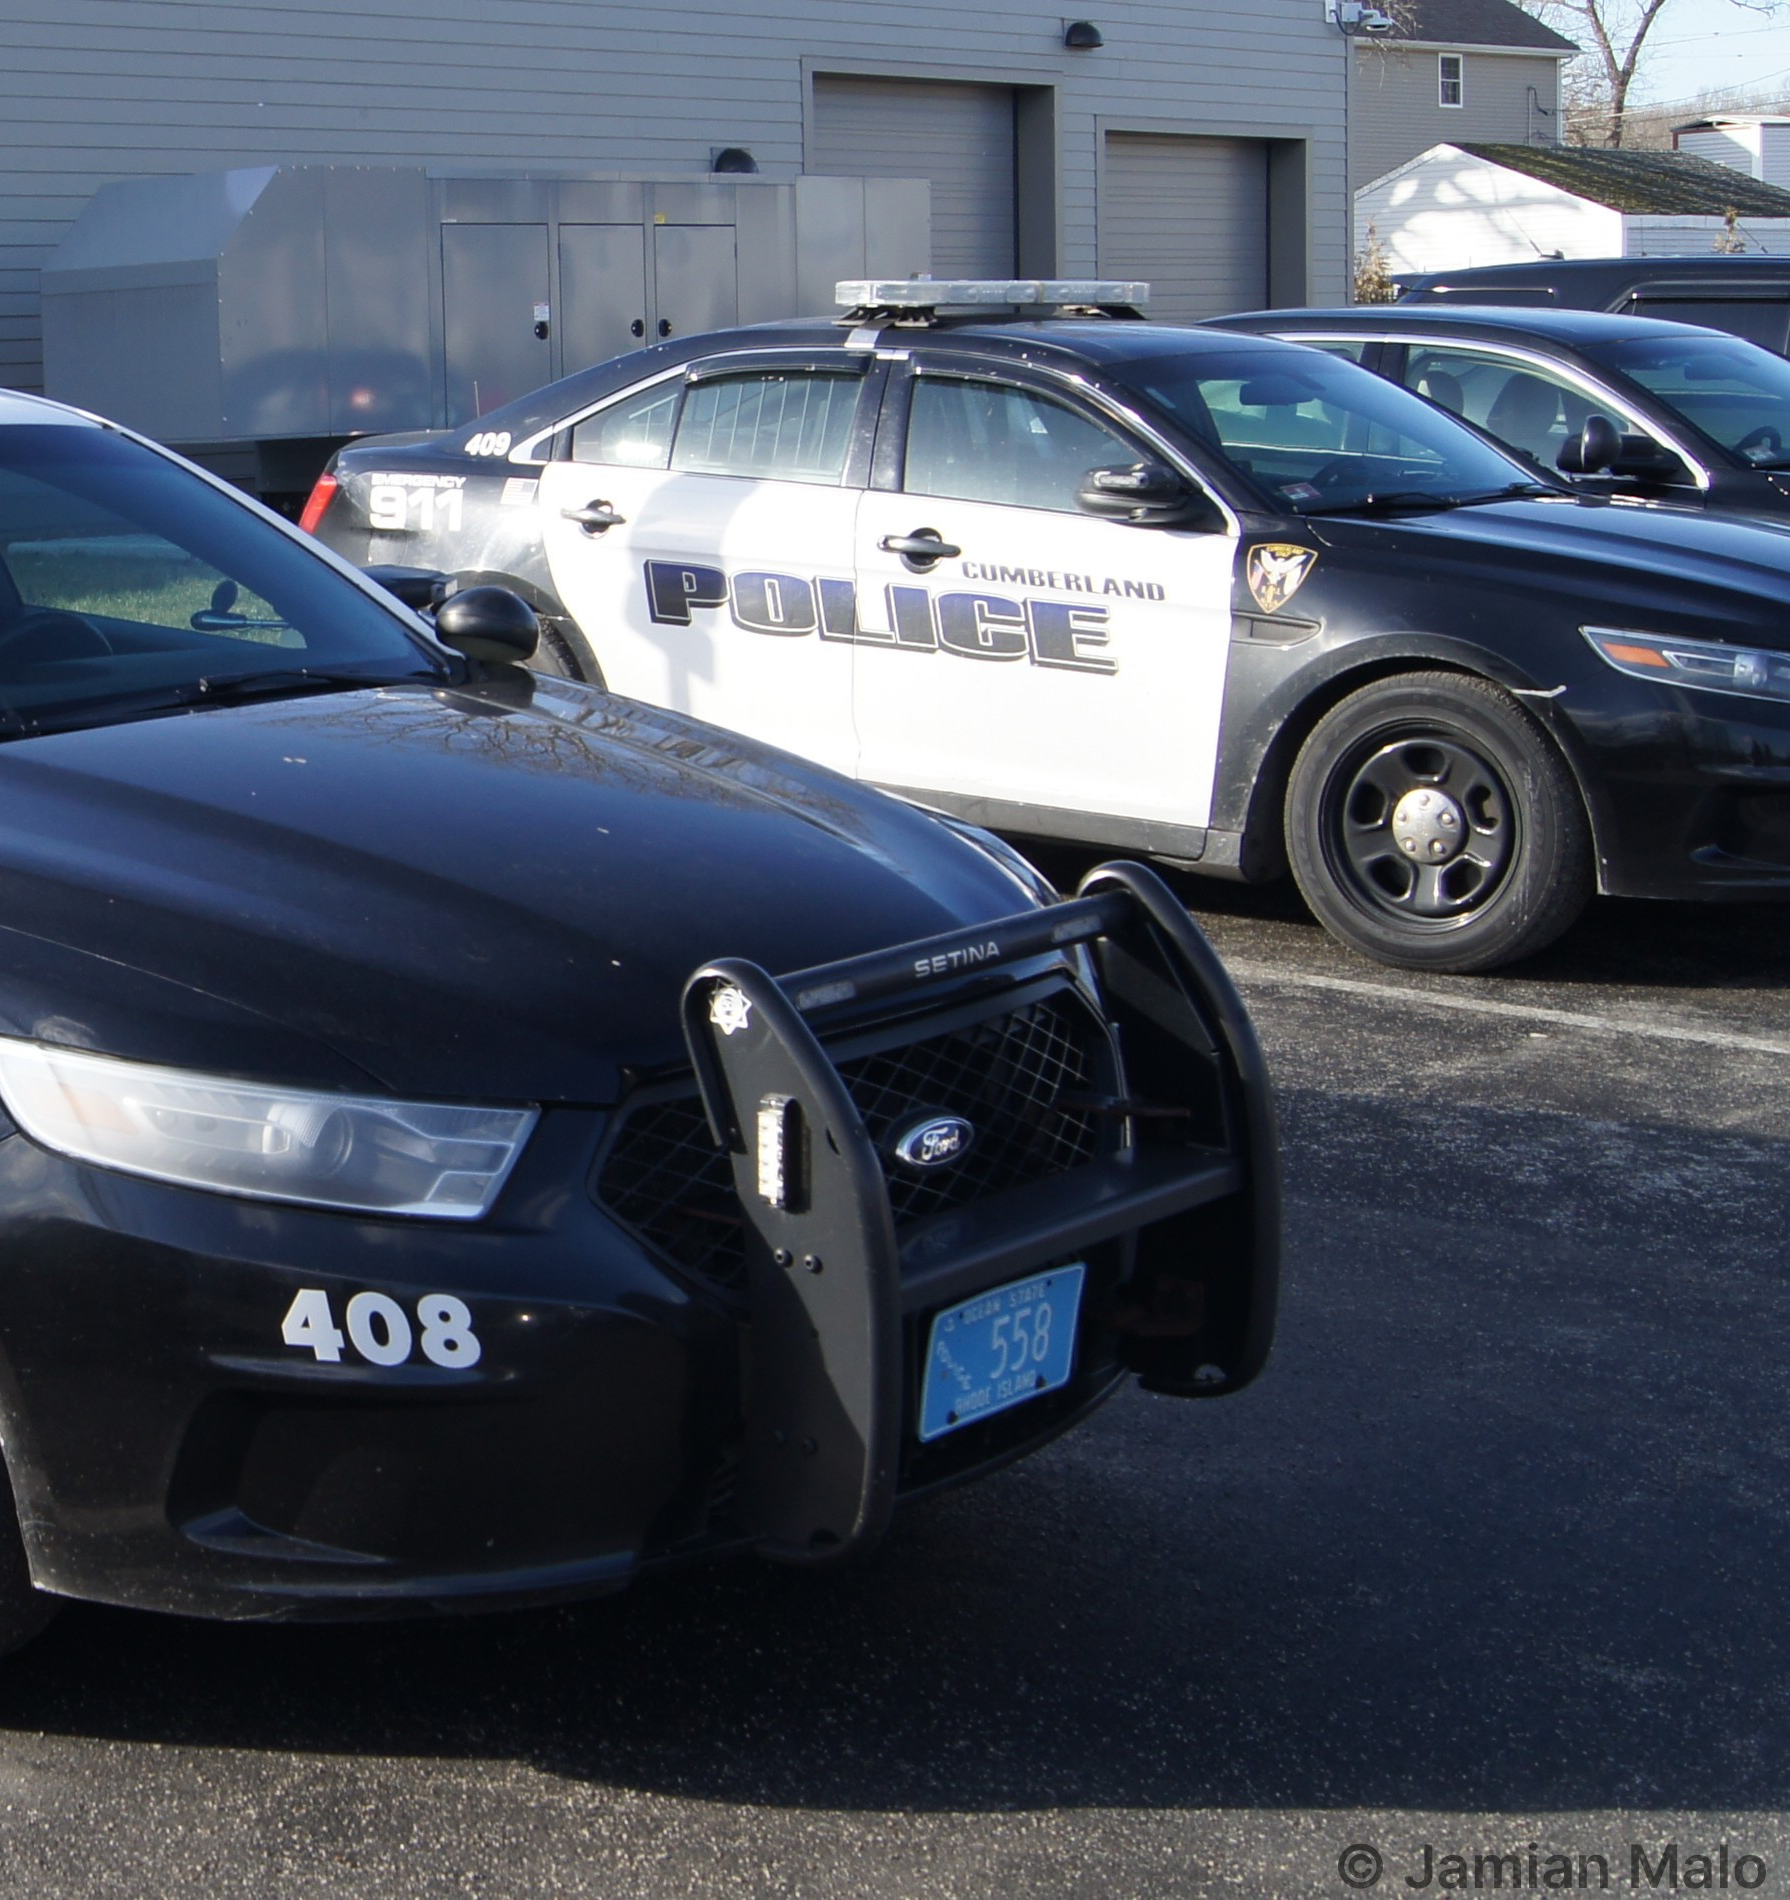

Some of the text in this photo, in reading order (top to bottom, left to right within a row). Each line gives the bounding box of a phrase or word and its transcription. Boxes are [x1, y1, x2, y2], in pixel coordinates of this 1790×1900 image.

[464, 431, 512, 457] 409
[371, 472, 467, 488] EMERGENCY
[369, 485, 464, 532] 911
[961, 560, 1166, 602] CUMBERLAND
[643, 558, 1119, 677] POLICE
[914, 941, 1001, 979] SETINA
[921, 1127, 961, 1161] Ford
[963, 1282, 1047, 1325] OCEAN STATE
[280, 1288, 482, 1369] 408
[989, 1301, 1053, 1380] 558
[954, 1369, 1037, 1415] RHODE ISLAND
